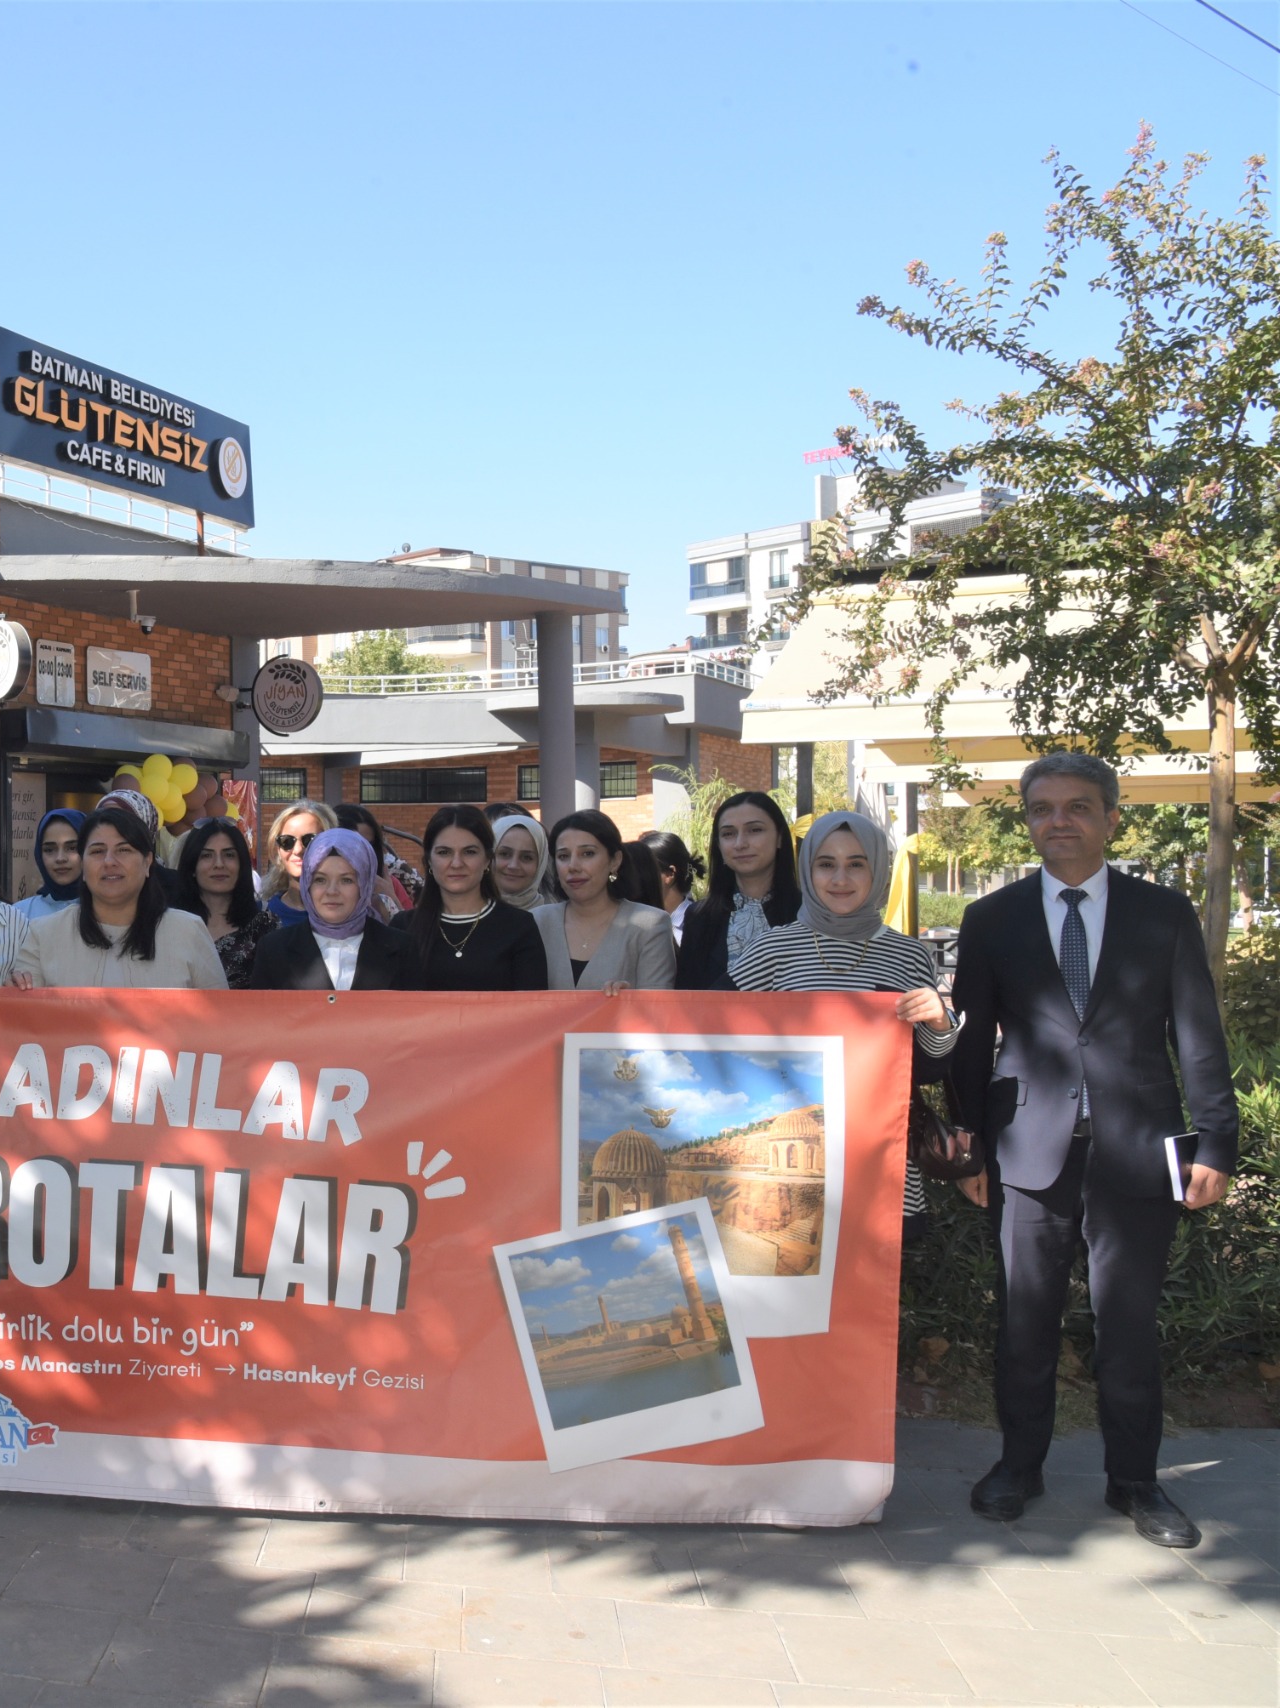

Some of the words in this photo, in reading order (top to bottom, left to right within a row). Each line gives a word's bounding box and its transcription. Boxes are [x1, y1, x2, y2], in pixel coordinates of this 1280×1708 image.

[31, 350, 103, 394] BATMAN
[111, 378, 195, 428] BELEDİYESİ
[14, 376, 209, 472] GLÜTENSİZ
[67, 440, 112, 471] CAFE
[114, 453, 126, 475] &
[128, 457, 165, 487] FIRIN
[92, 670, 113, 687] SELF
[116, 672, 147, 691] SERVİS
[269, 701, 301, 716] GLÜTENSİZ
[62, 1316, 123, 1343] dolu
[132, 1317, 173, 1345] bir
[20, 1355, 122, 1375] Manastırı
[128, 1358, 202, 1381] Ziyareti
[243, 1363, 357, 1391] Hasankeyf
[363, 1369, 425, 1391] Gezisi
